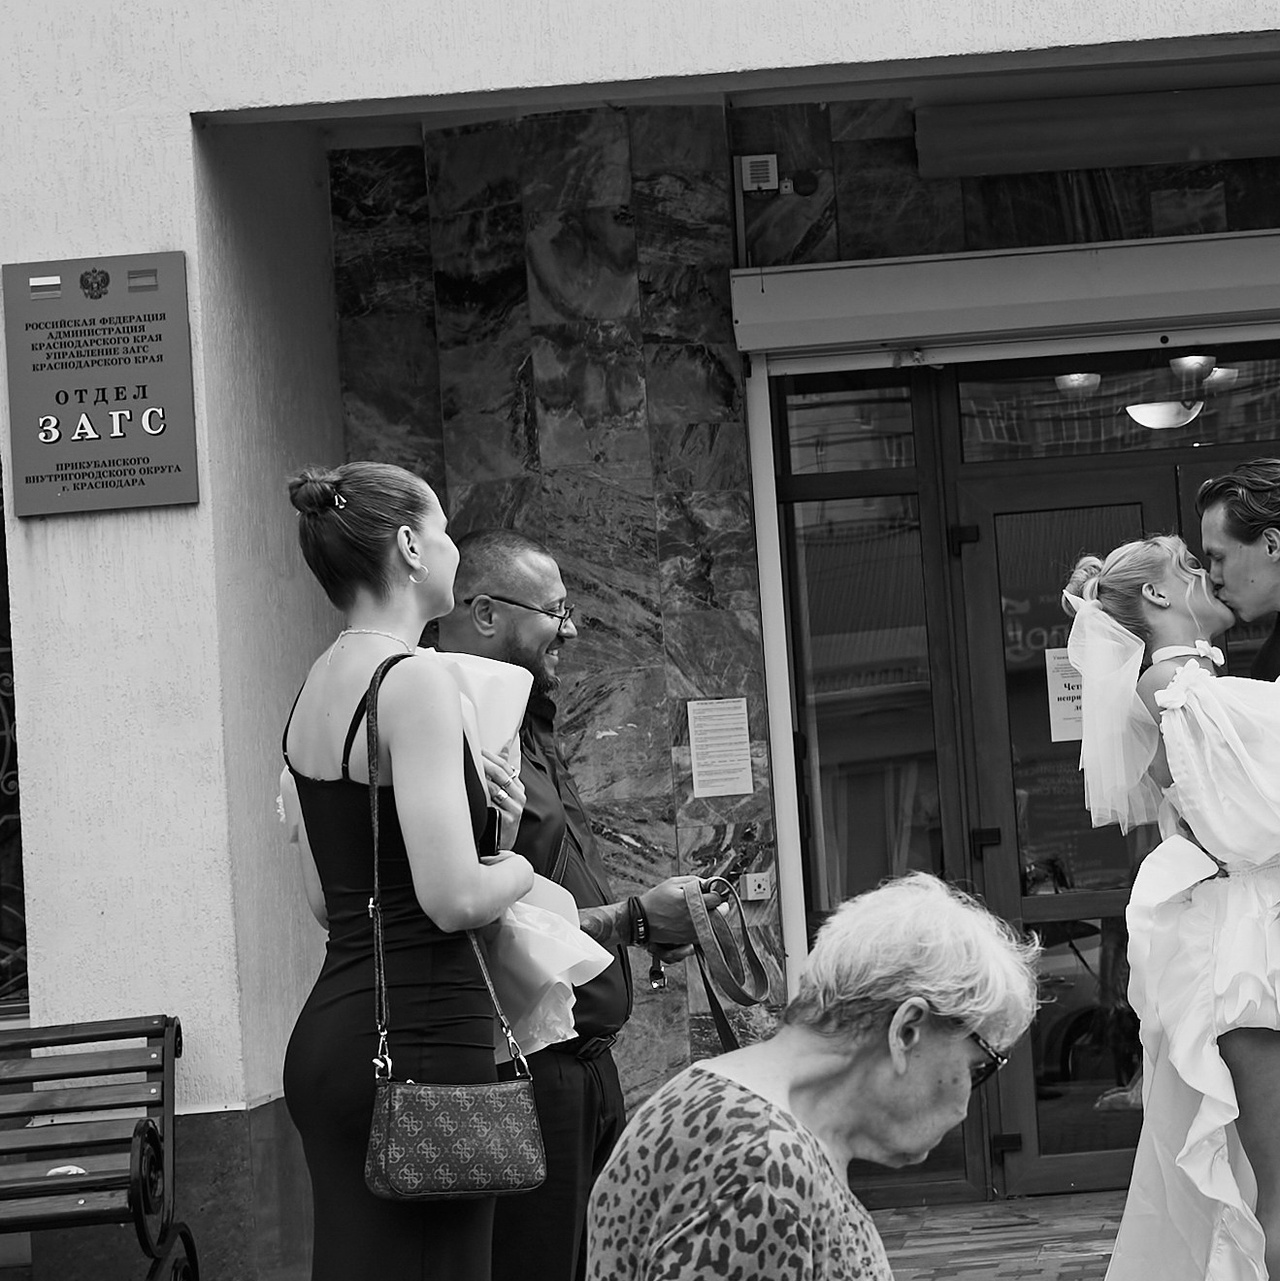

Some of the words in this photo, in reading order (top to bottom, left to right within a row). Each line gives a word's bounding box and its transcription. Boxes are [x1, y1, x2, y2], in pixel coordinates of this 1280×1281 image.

[25, 318, 96, 331] РОССИЙСКАЯ
[99, 313, 166, 326] ФЕДЕРАЦИЯ
[47, 325, 145, 340] АДМИНИСТРАЦИЯ
[31, 335, 130, 351] КРАСНОДАРСКОГО
[133, 334, 162, 343] КРАЯ
[46, 347, 119, 360] УПРАВЛЕНИЕ
[123, 345, 149, 354] ЗАГС
[32, 356, 131, 371] КРАСНОДАРСКОГО
[135, 354, 163, 364] КРАЯ
[55, 385, 148, 405] ОТДЕЛ
[38, 407, 166, 444] ЗАГС
[56, 457, 150, 471] ПРИКУБАНСКОГО
[25, 468, 136, 484] ВНУТРИГОРОДСКОГО
[139, 465, 182, 474] ОКРУГА
[73, 478, 145, 491] КРАСНОДАРА
